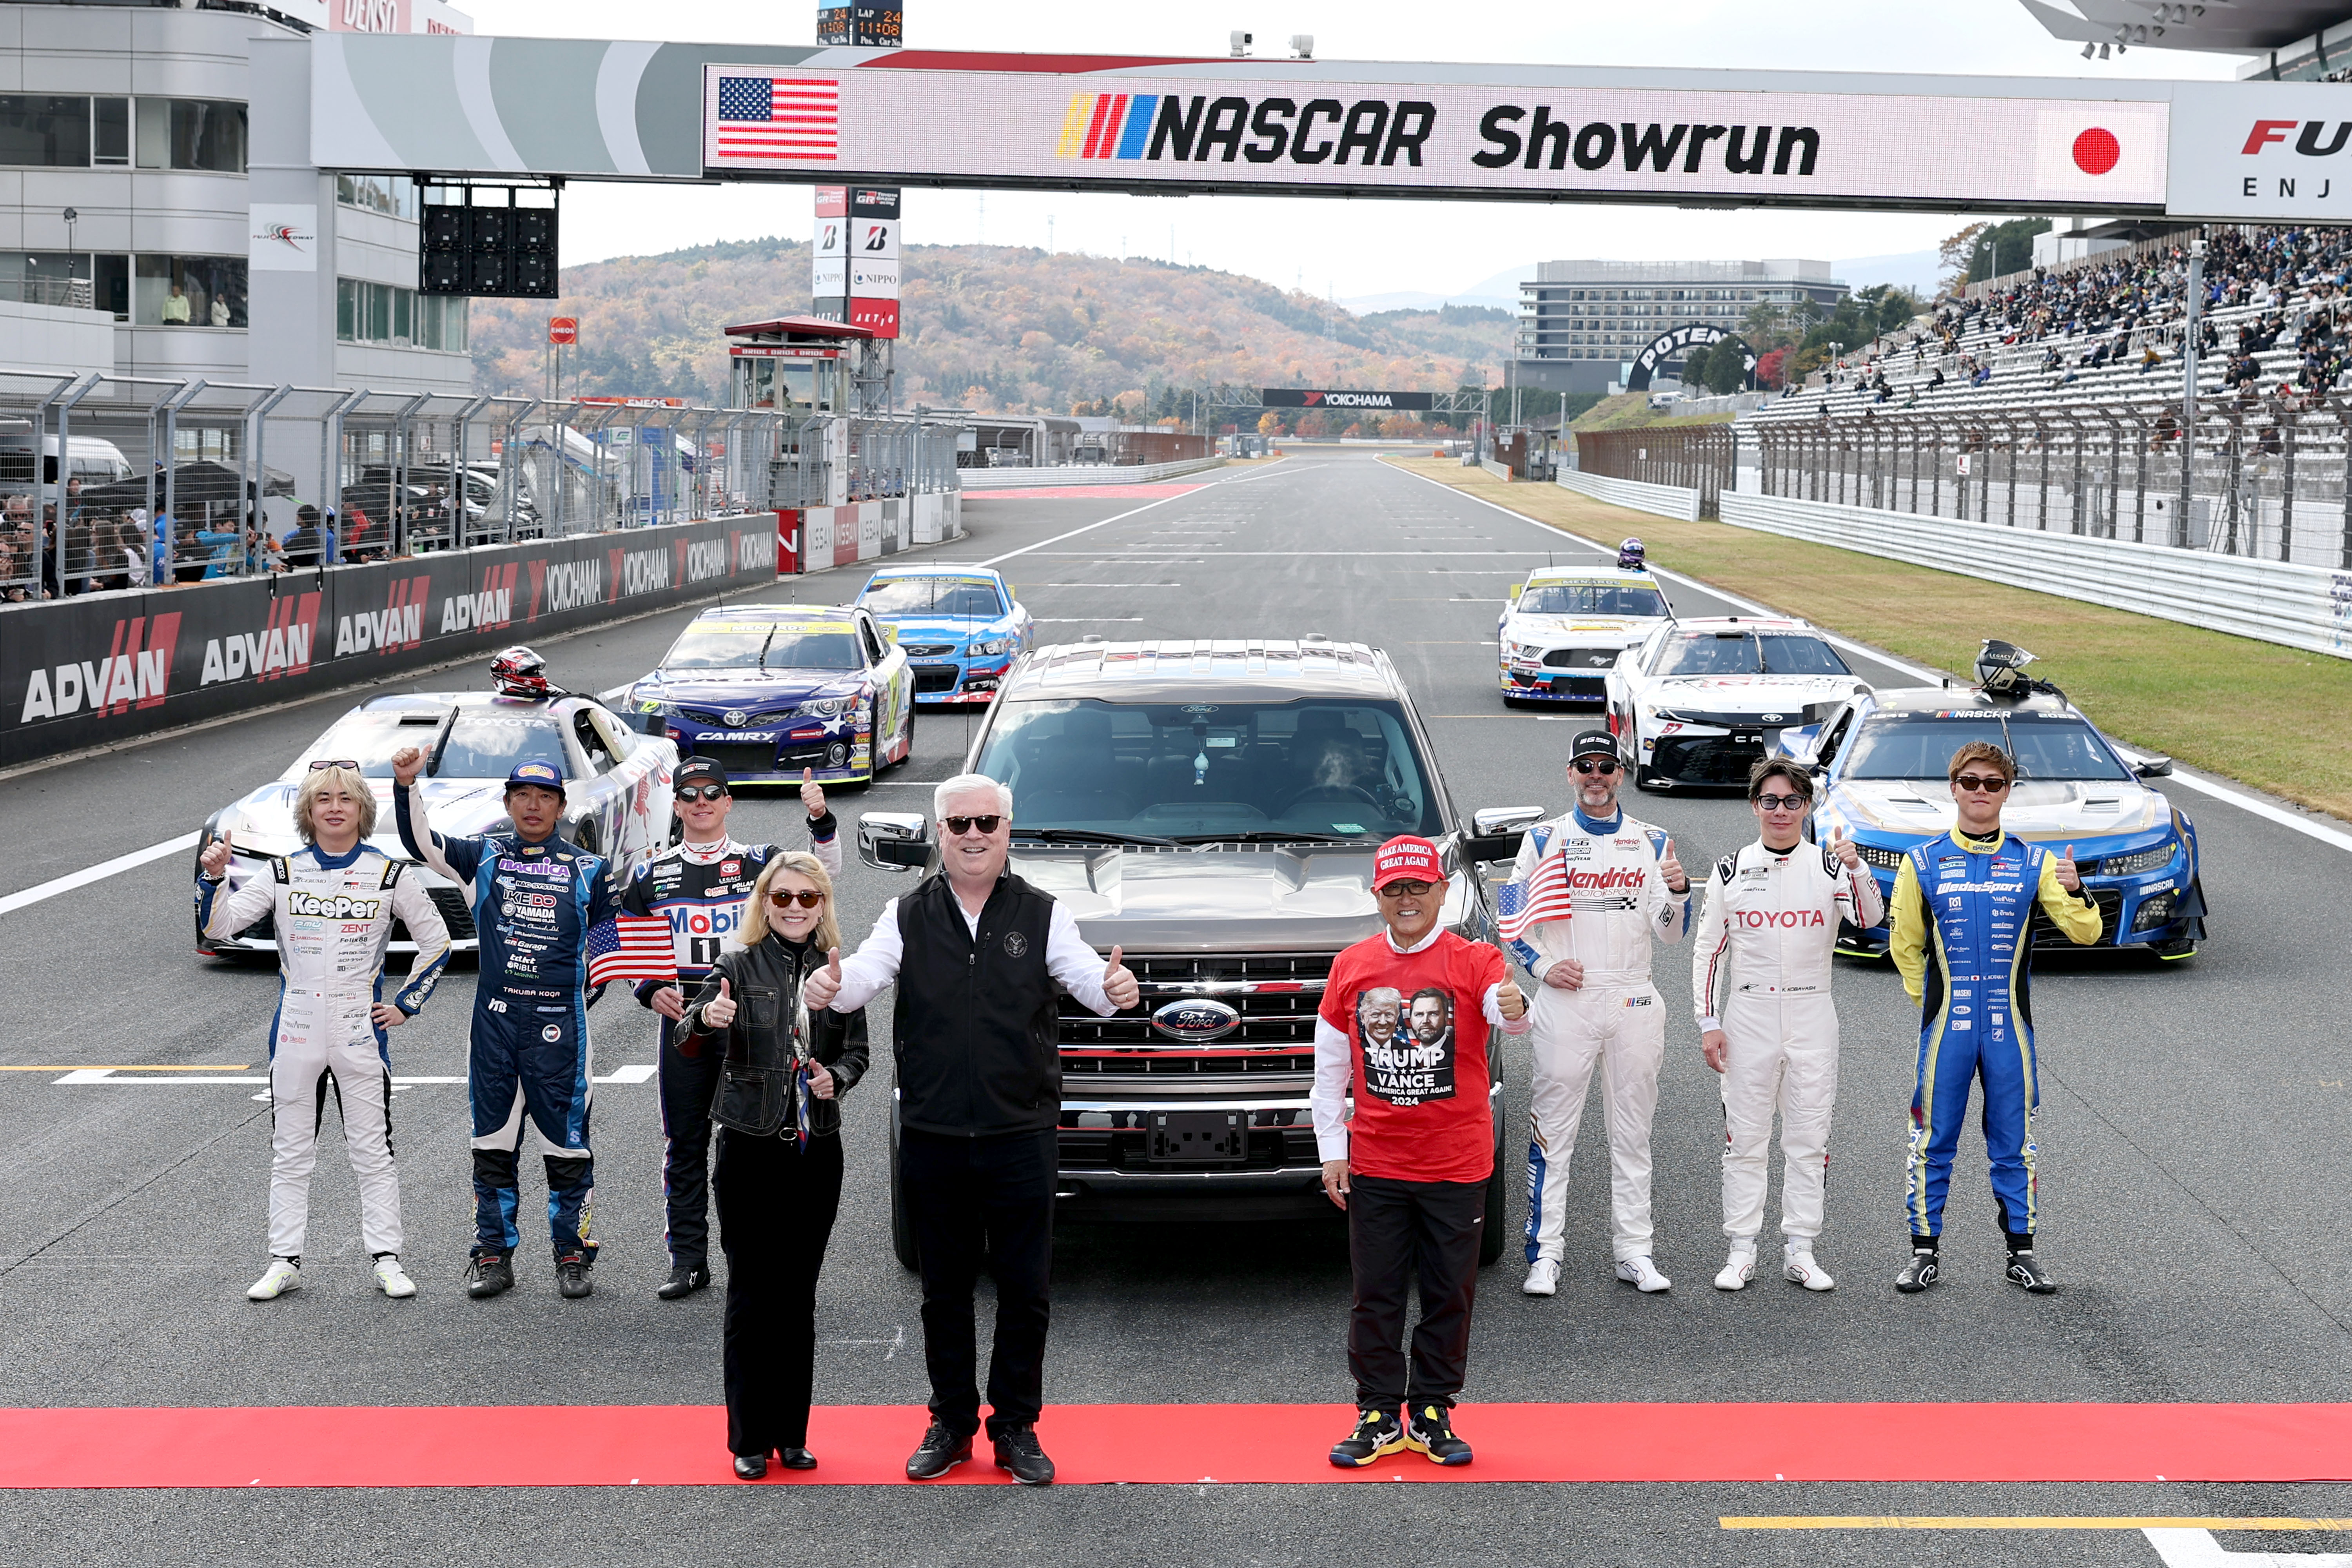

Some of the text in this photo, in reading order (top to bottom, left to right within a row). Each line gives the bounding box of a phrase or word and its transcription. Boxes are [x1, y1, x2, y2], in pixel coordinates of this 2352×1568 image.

[818, 8, 848, 20] LAP 24
[858, 9, 901, 23] LAP 24
[818, 22, 845, 34] 11:08
[859, 21, 899, 36] 11:08
[860, 36, 902, 47] Pos. Car No.
[1147, 94, 1820, 176] NASCAR Showrun
[2241, 120, 2352, 156] FU
[856, 195, 877, 204] GR
[823, 273, 843, 283] NIPPO
[866, 274, 897, 284] NIPPO
[855, 311, 894, 327] AKTIO
[1323, 393, 1393, 407] YOKOHAMA
[835, 523, 858, 546] NISSAN
[860, 517, 880, 542] NISSAN
[808, 527, 833, 551] NISSAN
[740, 531, 772, 570] YOKOHAMA
[687, 538, 726, 583] YOKOHAMA
[624, 547, 669, 596] YOKOHAMA
[546, 558, 601, 613] YOKOHAMA
[441, 588, 510, 634] ADVAN
[334, 604, 420, 657] ADVAN
[200, 623, 309, 686] ADVAN
[21, 649, 165, 724] ADVAN
[639, 701, 660, 712] 12
[1955, 710, 2011, 719] NASCAR
[464, 718, 549, 728] TOYOTA
[1660, 723, 1684, 734] 67
[695, 732, 776, 741] CAMRY
[681, 766, 695, 776] GR
[1378, 842, 1432, 860] MAKE AMERICA
[2031, 847, 2043, 867] sparco
[1380, 857, 1429, 870] GREAT AGAIN
[1912, 848, 1926, 871] sparco
[275, 858, 287, 880] sparco
[385, 862, 400, 886] sparco
[719, 875, 741, 883] LEGACY
[731, 880, 755, 889] DOLLAR
[2148, 878, 2174, 893] NASCAR
[532, 883, 569, 893] SYSTEMS
[1571, 888, 1641, 898] MOTORSPORTS
[1936, 881, 2024, 895] WedsSport
[289, 892, 379, 919] KeePer
[503, 889, 557, 908] IKEDO
[516, 906, 556, 918] YAMADA
[1736, 910, 1824, 928] TOYOTA
[341, 924, 371, 933] ZENT
[504, 938, 518, 947] GR
[518, 940, 548, 951] Garage
[698, 939, 711, 963] 1
[405, 964, 444, 1009] KeePer
[503, 986, 536, 996] TAKUMA
[1175, 1011, 1216, 1028] Ford
[1365, 1047, 1445, 1069] TRUMP
[1377, 1073, 1435, 1088] VANCE
[1378, 1087, 1406, 1096] AMERICA
[1429, 1085, 1452, 1094] AGAIN!
[1392, 1096, 1419, 1106] 2024
